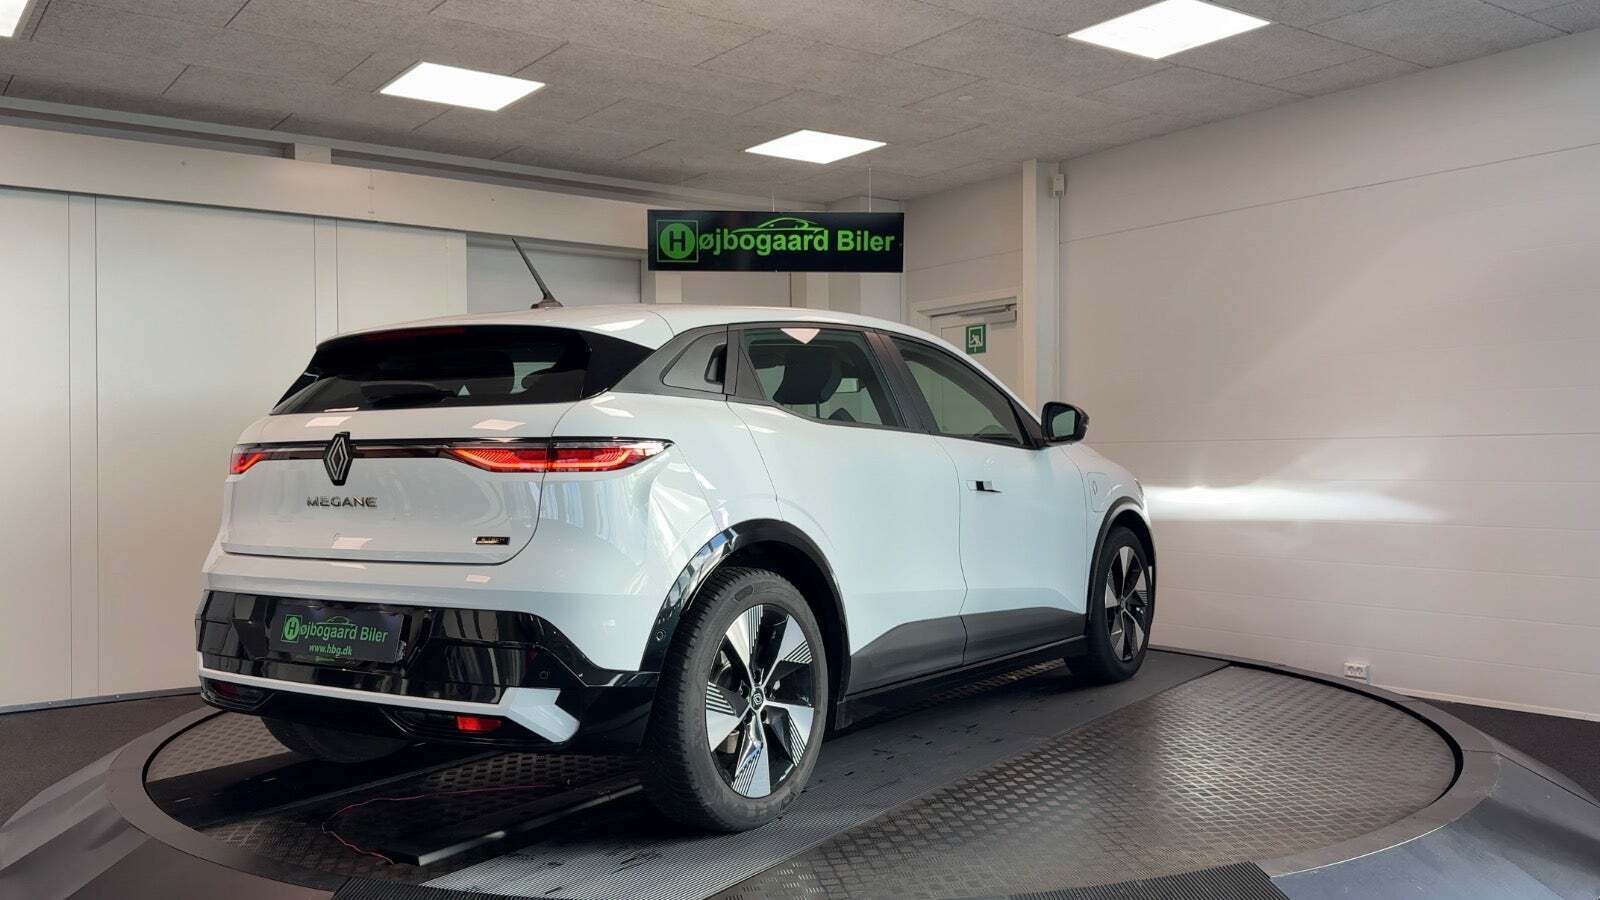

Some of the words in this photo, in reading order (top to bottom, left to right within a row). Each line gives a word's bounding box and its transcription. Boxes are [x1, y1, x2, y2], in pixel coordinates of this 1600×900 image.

[837, 230, 895, 252] Biler
[307, 496, 377, 507] MEGANE
[360, 626, 388, 642] Biler
[309, 643, 353, 656] www.hbg.dk
